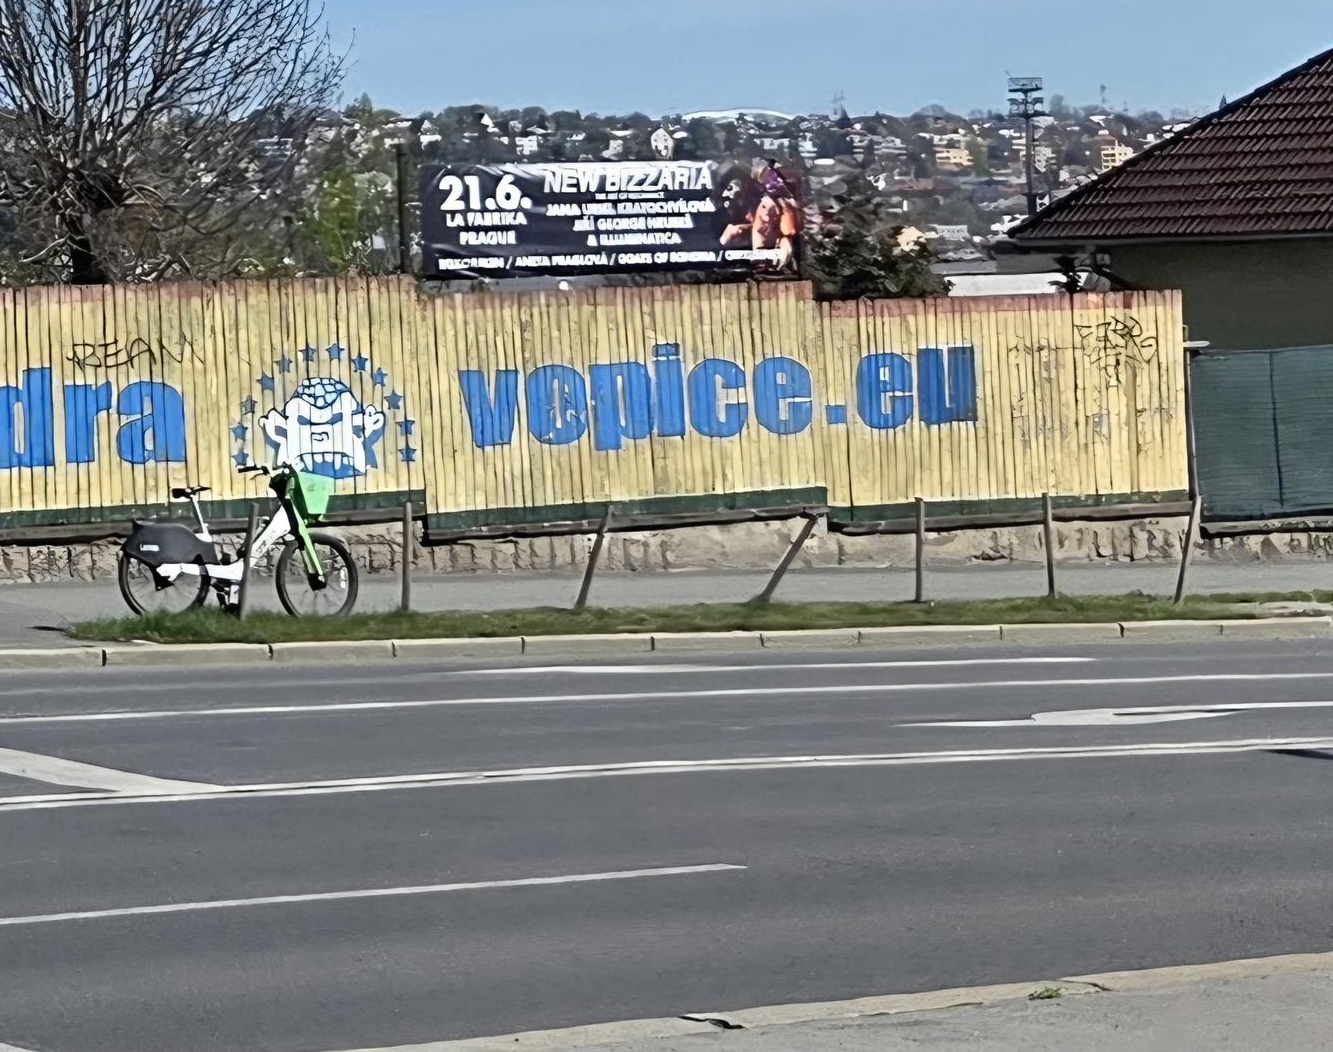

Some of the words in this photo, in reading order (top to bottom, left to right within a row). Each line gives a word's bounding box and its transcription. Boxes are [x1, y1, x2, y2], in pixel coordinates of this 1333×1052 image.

[438, 174, 533, 210] 21.6.
[544, 168, 600, 193] NEW
[604, 162, 713, 192] BIZZARIA
[458, 343, 977, 451] vopice.eu
